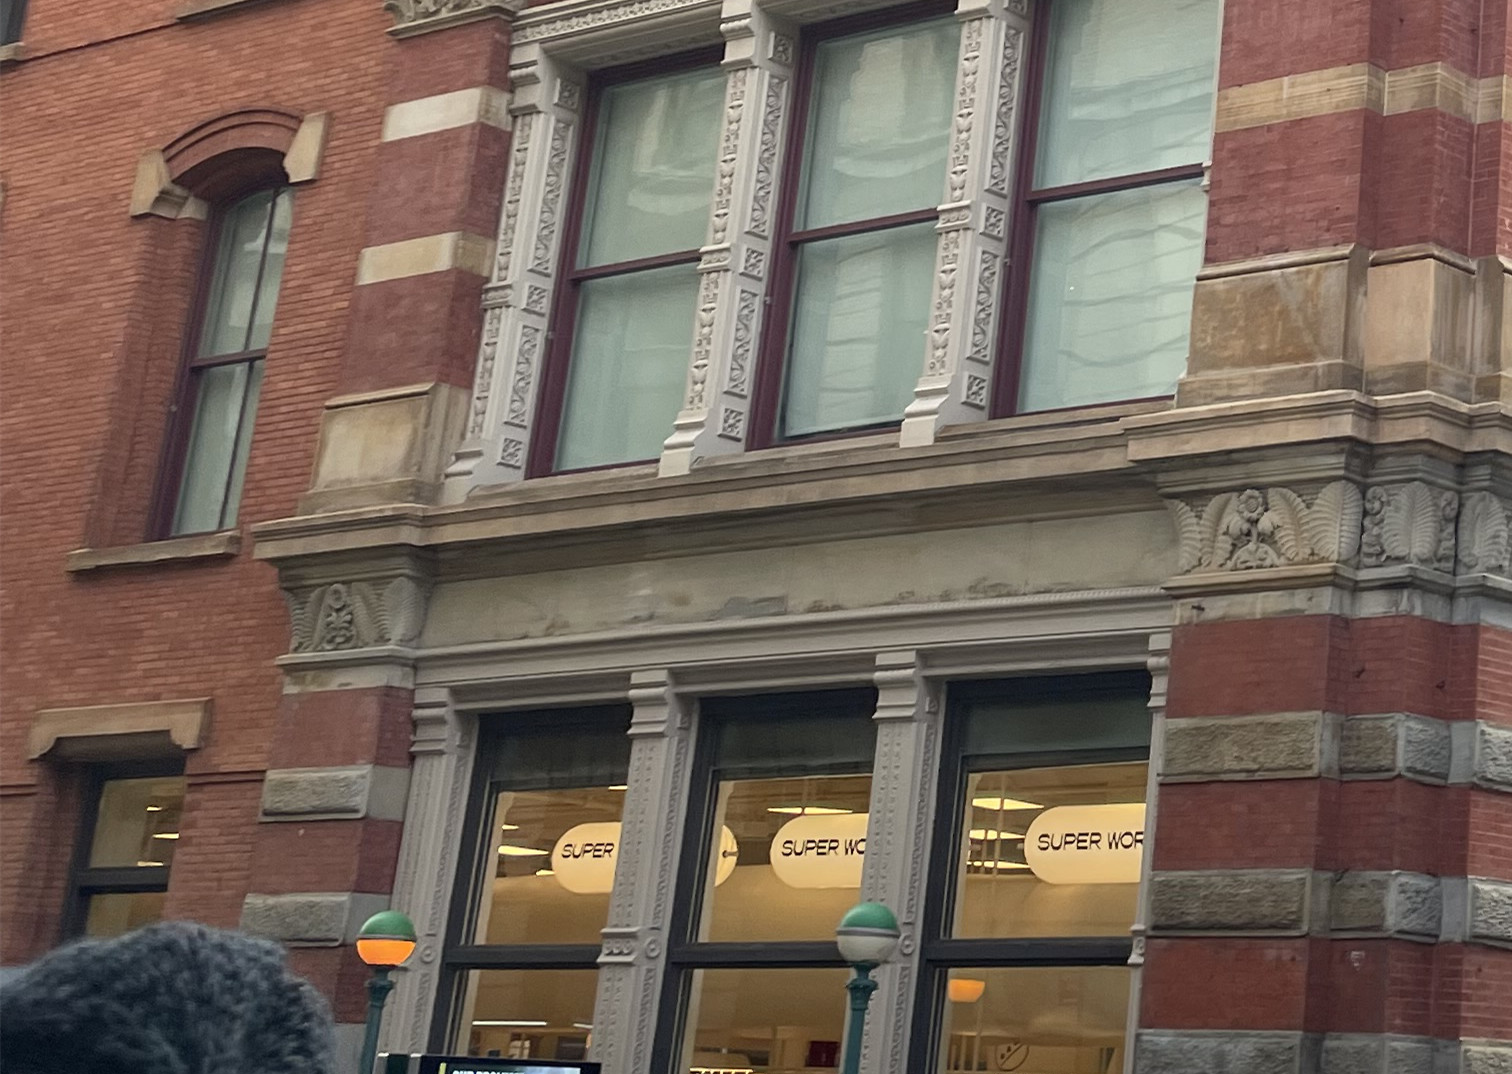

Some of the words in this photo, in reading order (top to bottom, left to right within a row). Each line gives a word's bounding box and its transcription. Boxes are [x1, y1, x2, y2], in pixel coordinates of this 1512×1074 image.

[561, 842, 614, 859] SUPER
[781, 838, 839, 857] SUPER
[1037, 832, 1102, 851] SUPER
